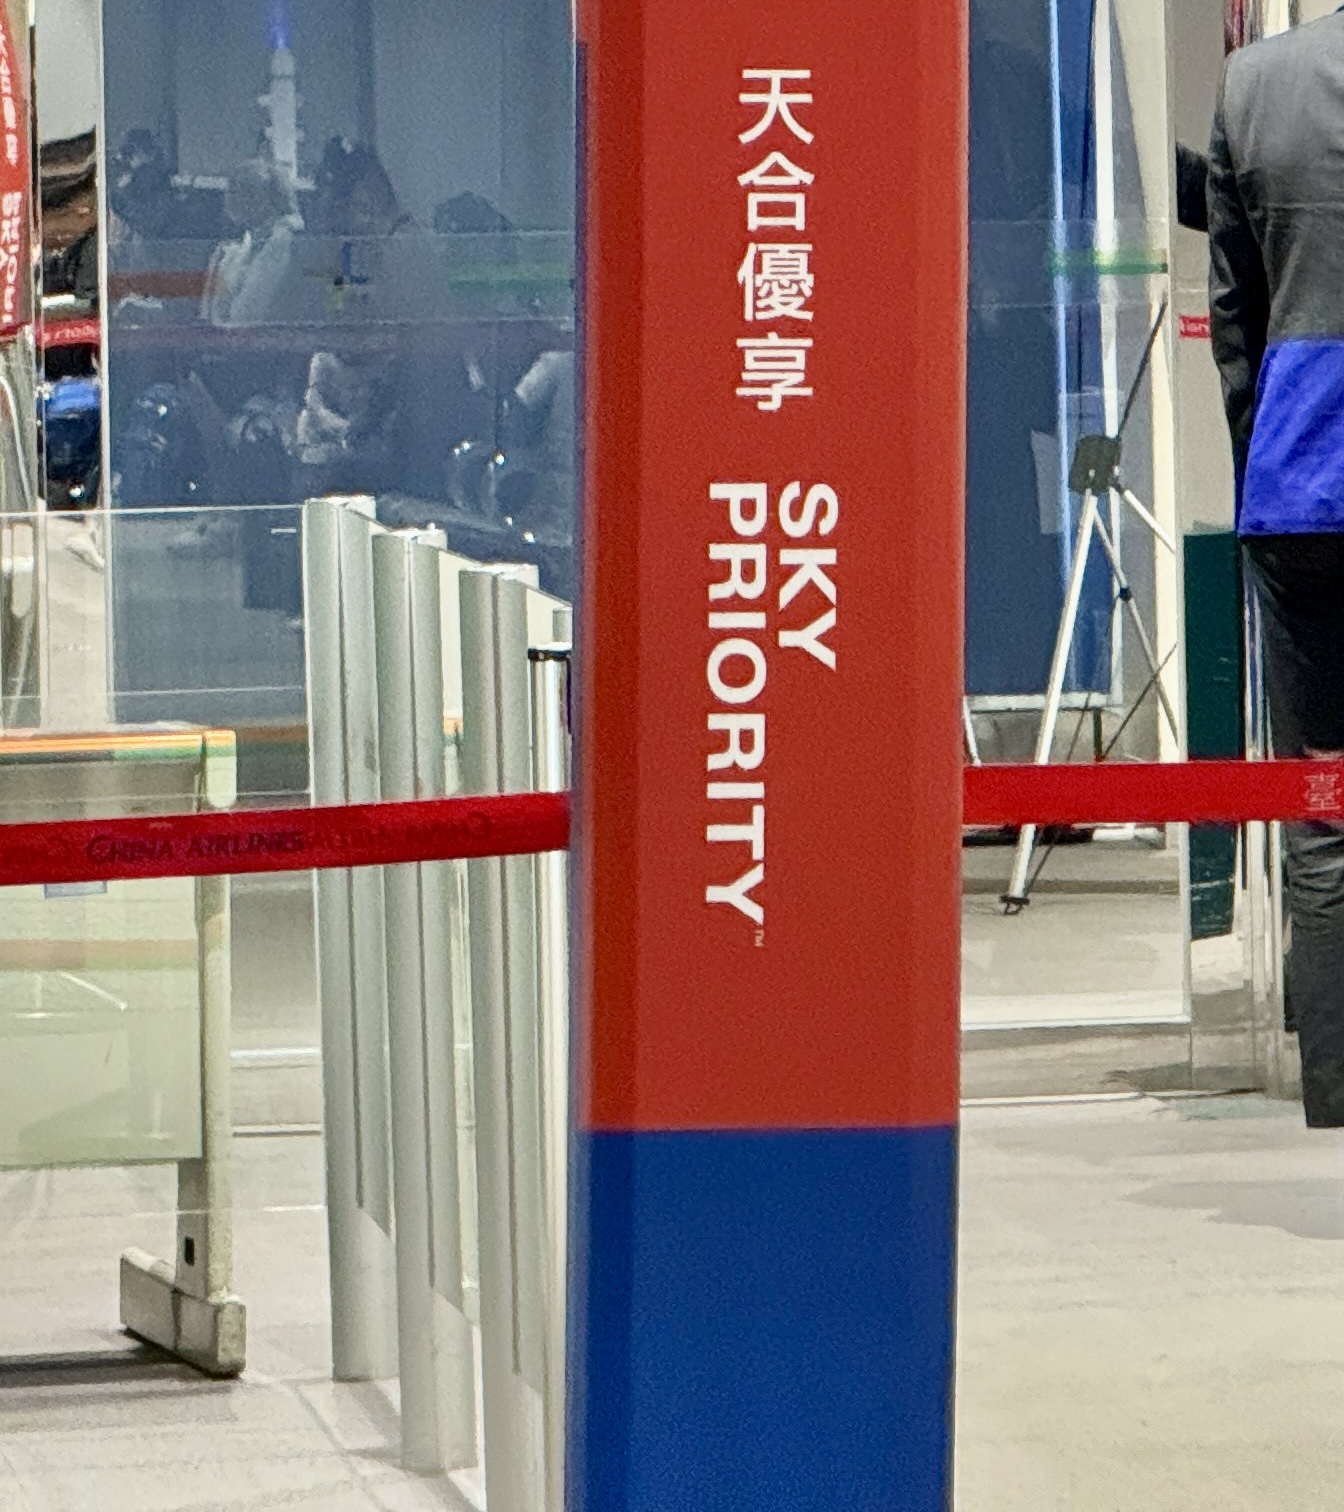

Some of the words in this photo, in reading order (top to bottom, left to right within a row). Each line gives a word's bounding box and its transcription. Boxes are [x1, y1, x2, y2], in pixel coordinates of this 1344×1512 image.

[735, 67, 815, 411] 天合優享
[778, 480, 839, 671] SKY
